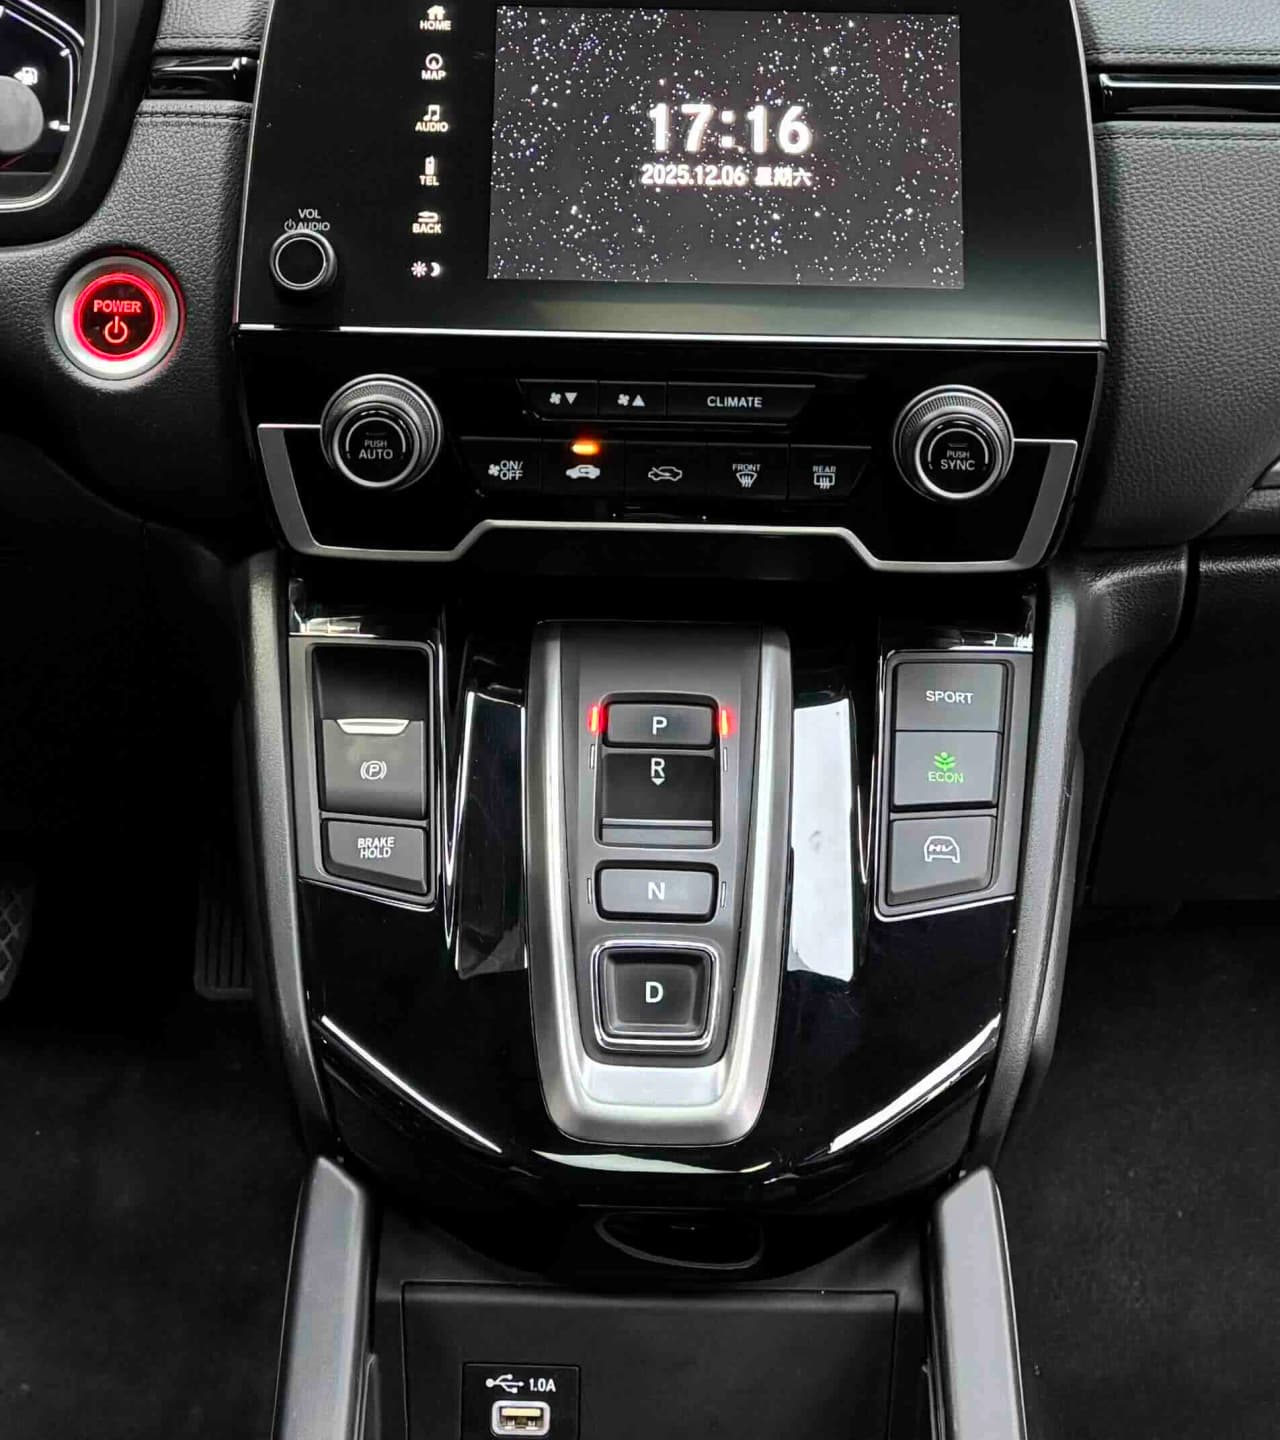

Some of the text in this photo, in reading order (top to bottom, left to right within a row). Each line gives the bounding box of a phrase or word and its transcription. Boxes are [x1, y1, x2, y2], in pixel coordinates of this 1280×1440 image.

[419, 20, 452, 31] HOME
[421, 70, 447, 81] MAP
[415, 122, 449, 133] AUDIO
[648, 103, 813, 155] 17:16
[420, 175, 440, 187] TEL
[640, 164, 813, 187] 2025.12.06 星期六
[298, 208, 321, 220] VOL
[412, 223, 442, 234] BACK
[93, 299, 141, 313] POWER
[706, 395, 763, 409] CLIMATE
[364, 439, 388, 448] PUSH
[358, 448, 394, 460] AUTO
[946, 450, 970, 459] PUSH
[500, 460, 523, 471] ON/
[732, 464, 761, 472] FRONT
[812, 465, 837, 474] REAR
[940, 458, 976, 472] SYNC
[500, 470, 523, 481] OFF
[926, 690, 974, 705] SPORT
[651, 716, 668, 735] P
[650, 757, 666, 778] R
[928, 771, 964, 784] ECON
[357, 836, 396, 849] BRAKE
[360, 847, 392, 859] HOLD
[647, 881, 666, 900] N
[644, 981, 664, 1004] D
[529, 1377, 557, 1393] 1.0A
